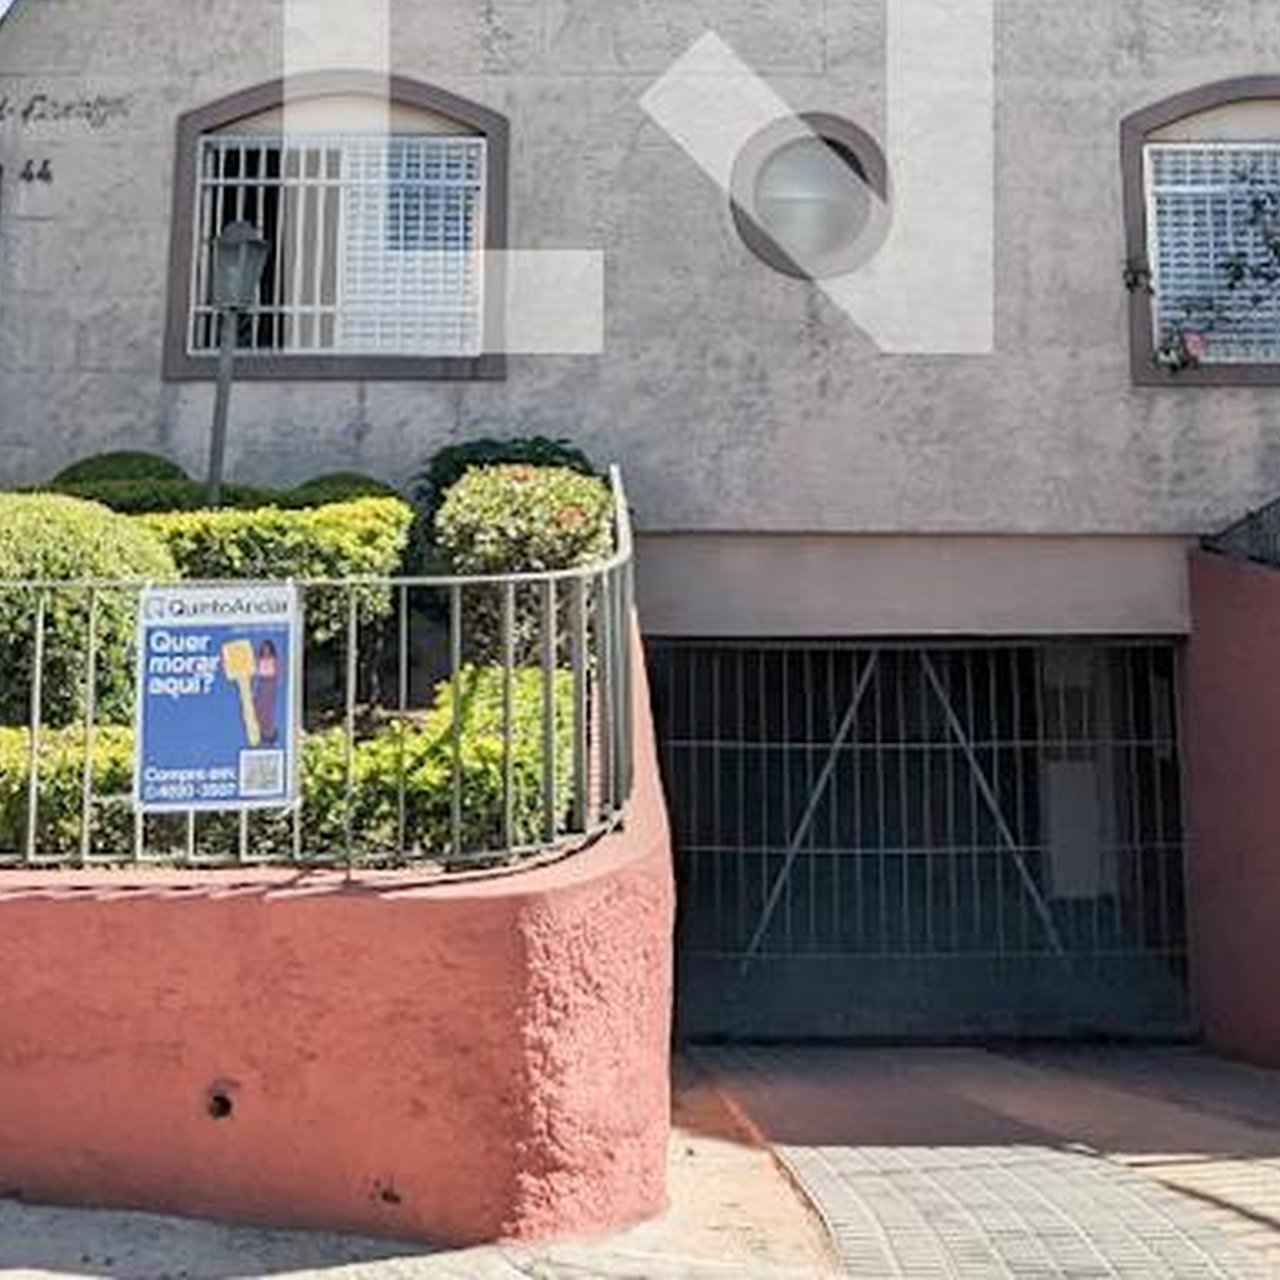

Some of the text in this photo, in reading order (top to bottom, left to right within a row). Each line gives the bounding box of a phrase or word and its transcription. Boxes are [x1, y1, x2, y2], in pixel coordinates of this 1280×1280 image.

[170, 598, 288, 616] QuintoAndar
[150, 631, 213, 653] Quer
[149, 656, 220, 675] morar
[149, 672, 215, 700] aqui?
